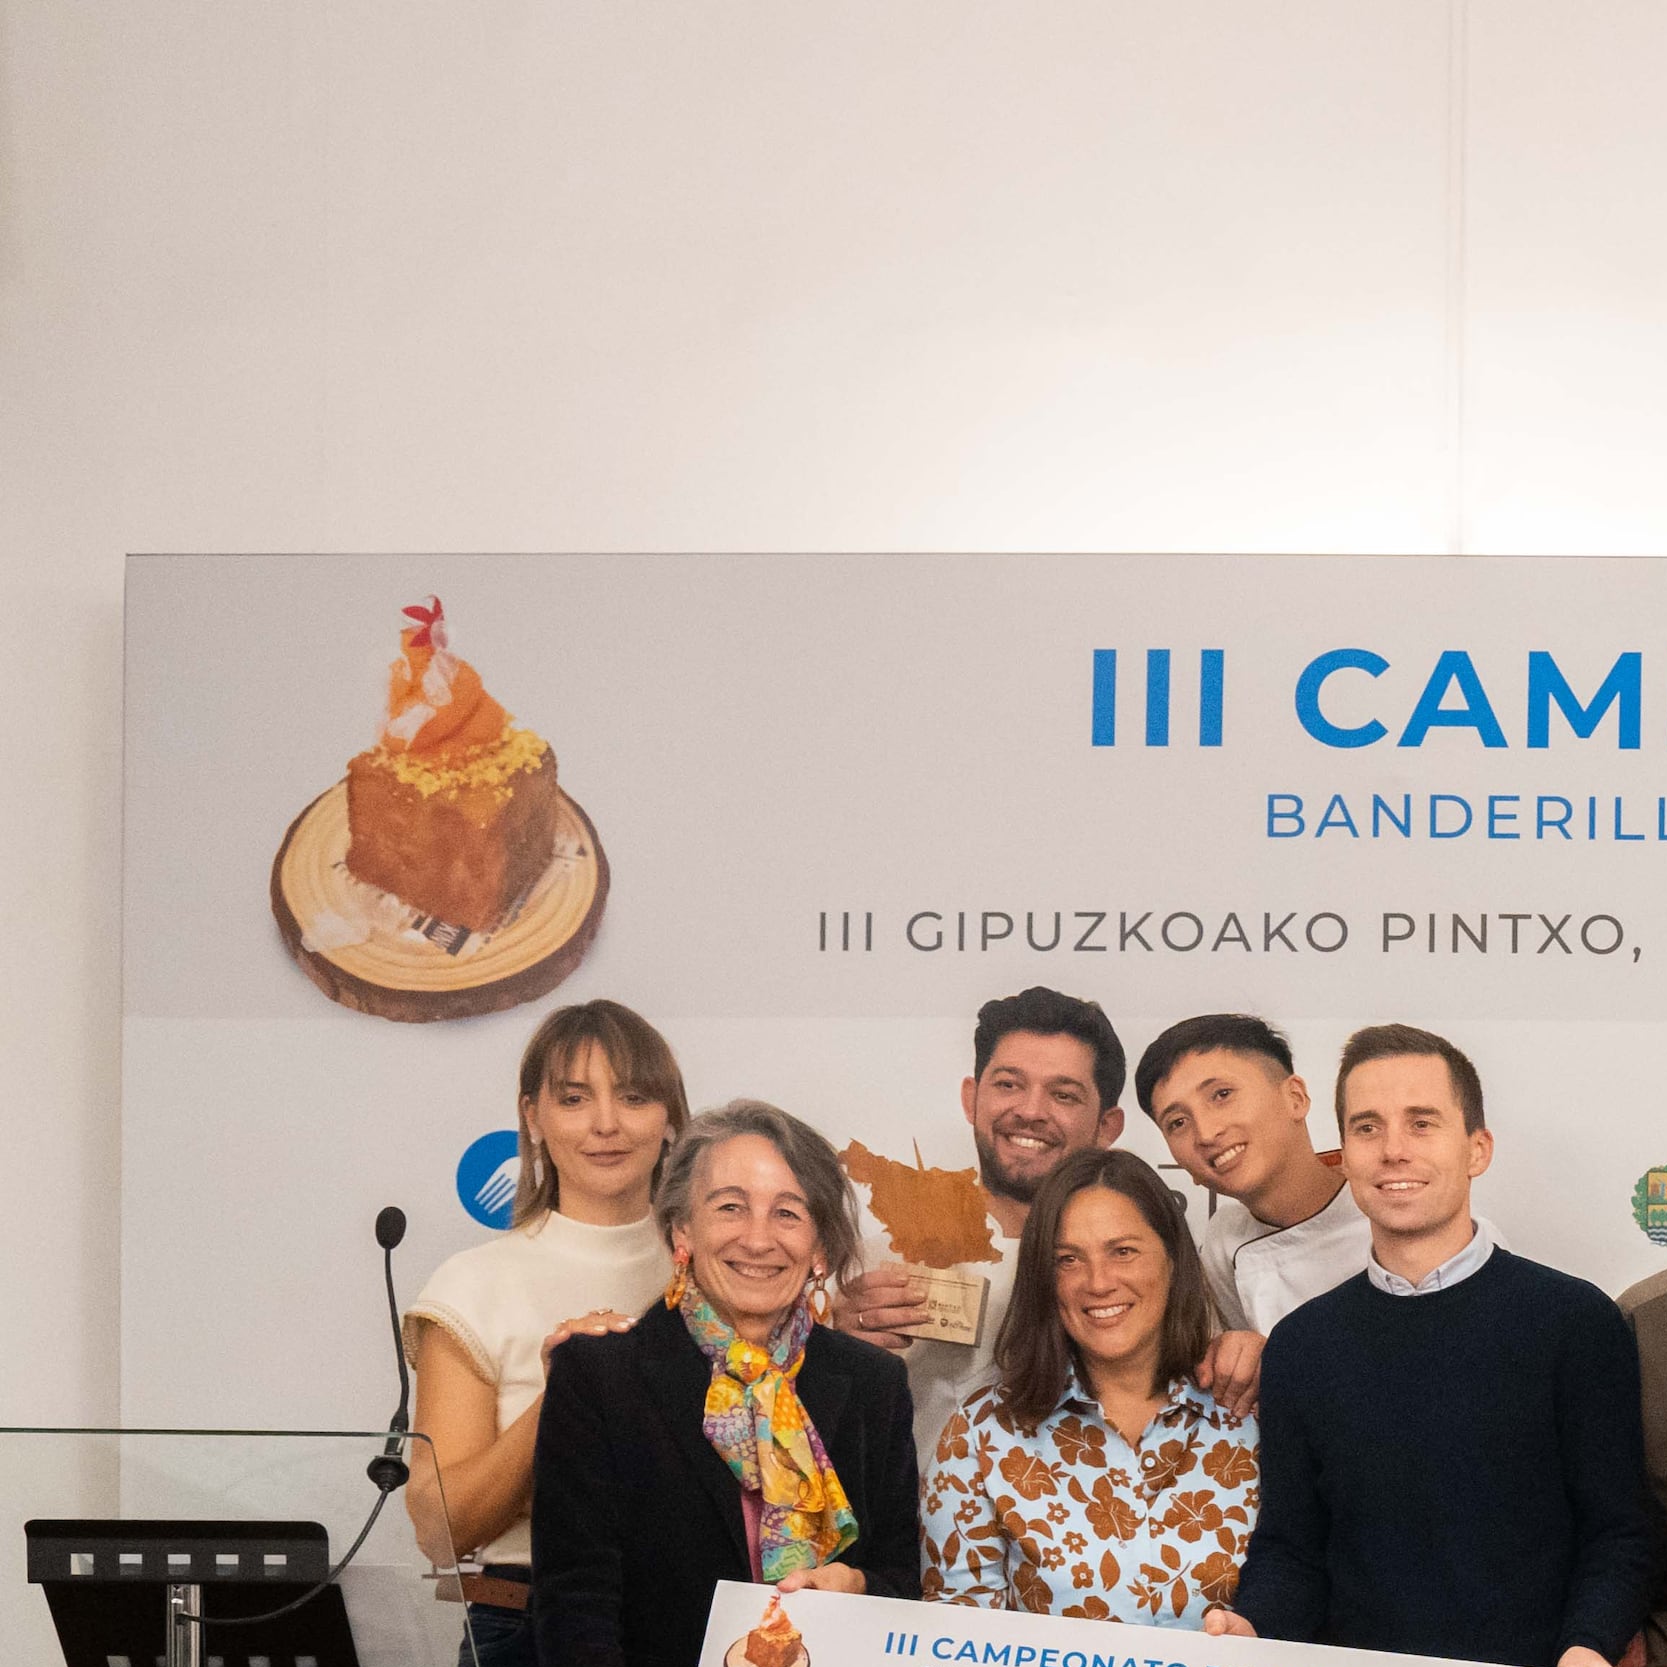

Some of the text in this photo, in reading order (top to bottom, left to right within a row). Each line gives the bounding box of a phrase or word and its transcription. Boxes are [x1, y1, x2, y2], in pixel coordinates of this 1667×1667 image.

[1091, 649, 1224, 746] III
[820, 912, 872, 951] III
[906, 911, 1348, 952] GIPUZKOAKO
[1383, 912, 1641, 962] PINTXO,
[885, 1632, 918, 1656] III
